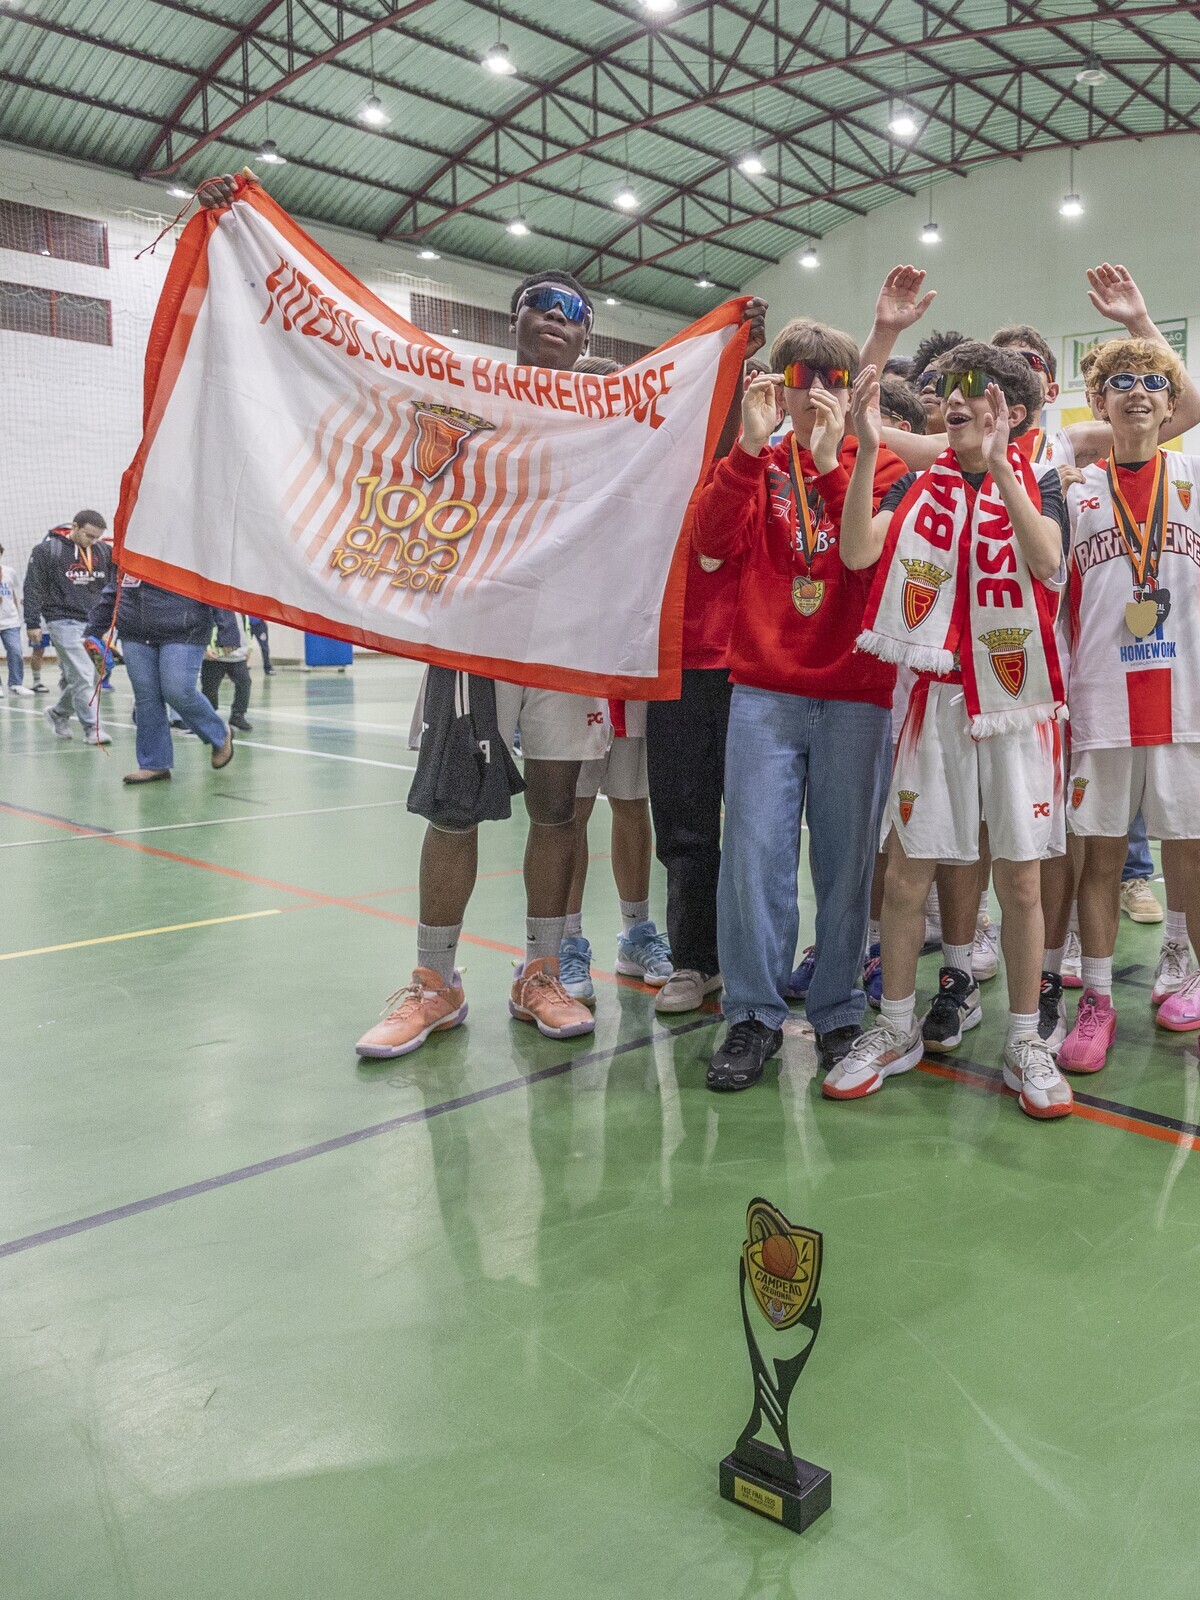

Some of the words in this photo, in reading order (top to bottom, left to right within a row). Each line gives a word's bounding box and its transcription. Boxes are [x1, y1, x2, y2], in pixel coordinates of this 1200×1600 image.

[371, 331, 466, 388] CLUBE
[472, 355, 675, 430] BARREIRENSE
[356, 475, 479, 541] 100
[332, 549, 448, 593] 1911-2011
[345, 525, 460, 572] anos
[1120, 642, 1177, 662] HOMEWORK
